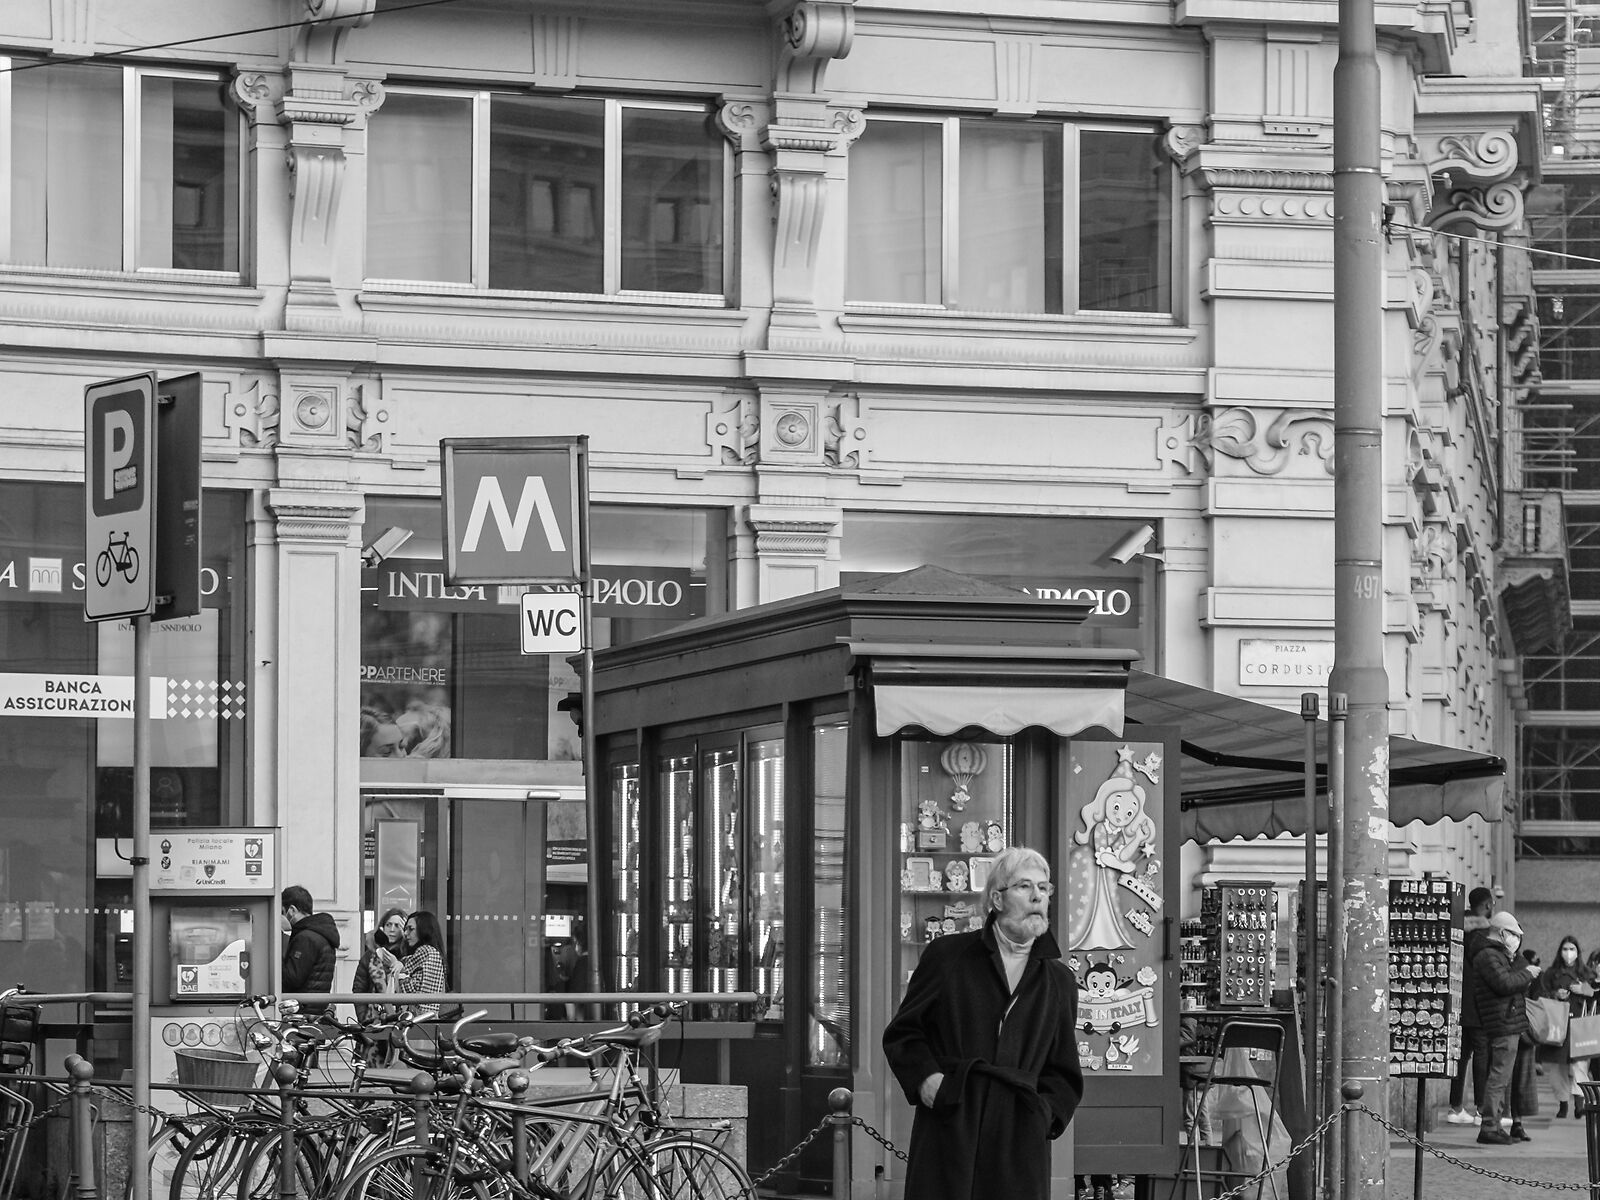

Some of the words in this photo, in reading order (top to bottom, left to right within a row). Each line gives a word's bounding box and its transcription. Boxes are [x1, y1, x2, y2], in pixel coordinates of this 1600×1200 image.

[105, 409, 135, 500] P
[460, 476, 567, 552] M
[527, 609, 578, 637] WC
[1275, 645, 1307, 653] PIAZZA
[45, 680, 102, 694] BANCA
[1095, 1009, 1108, 1020] IN
[1109, 1001, 1142, 1020] ITALY
